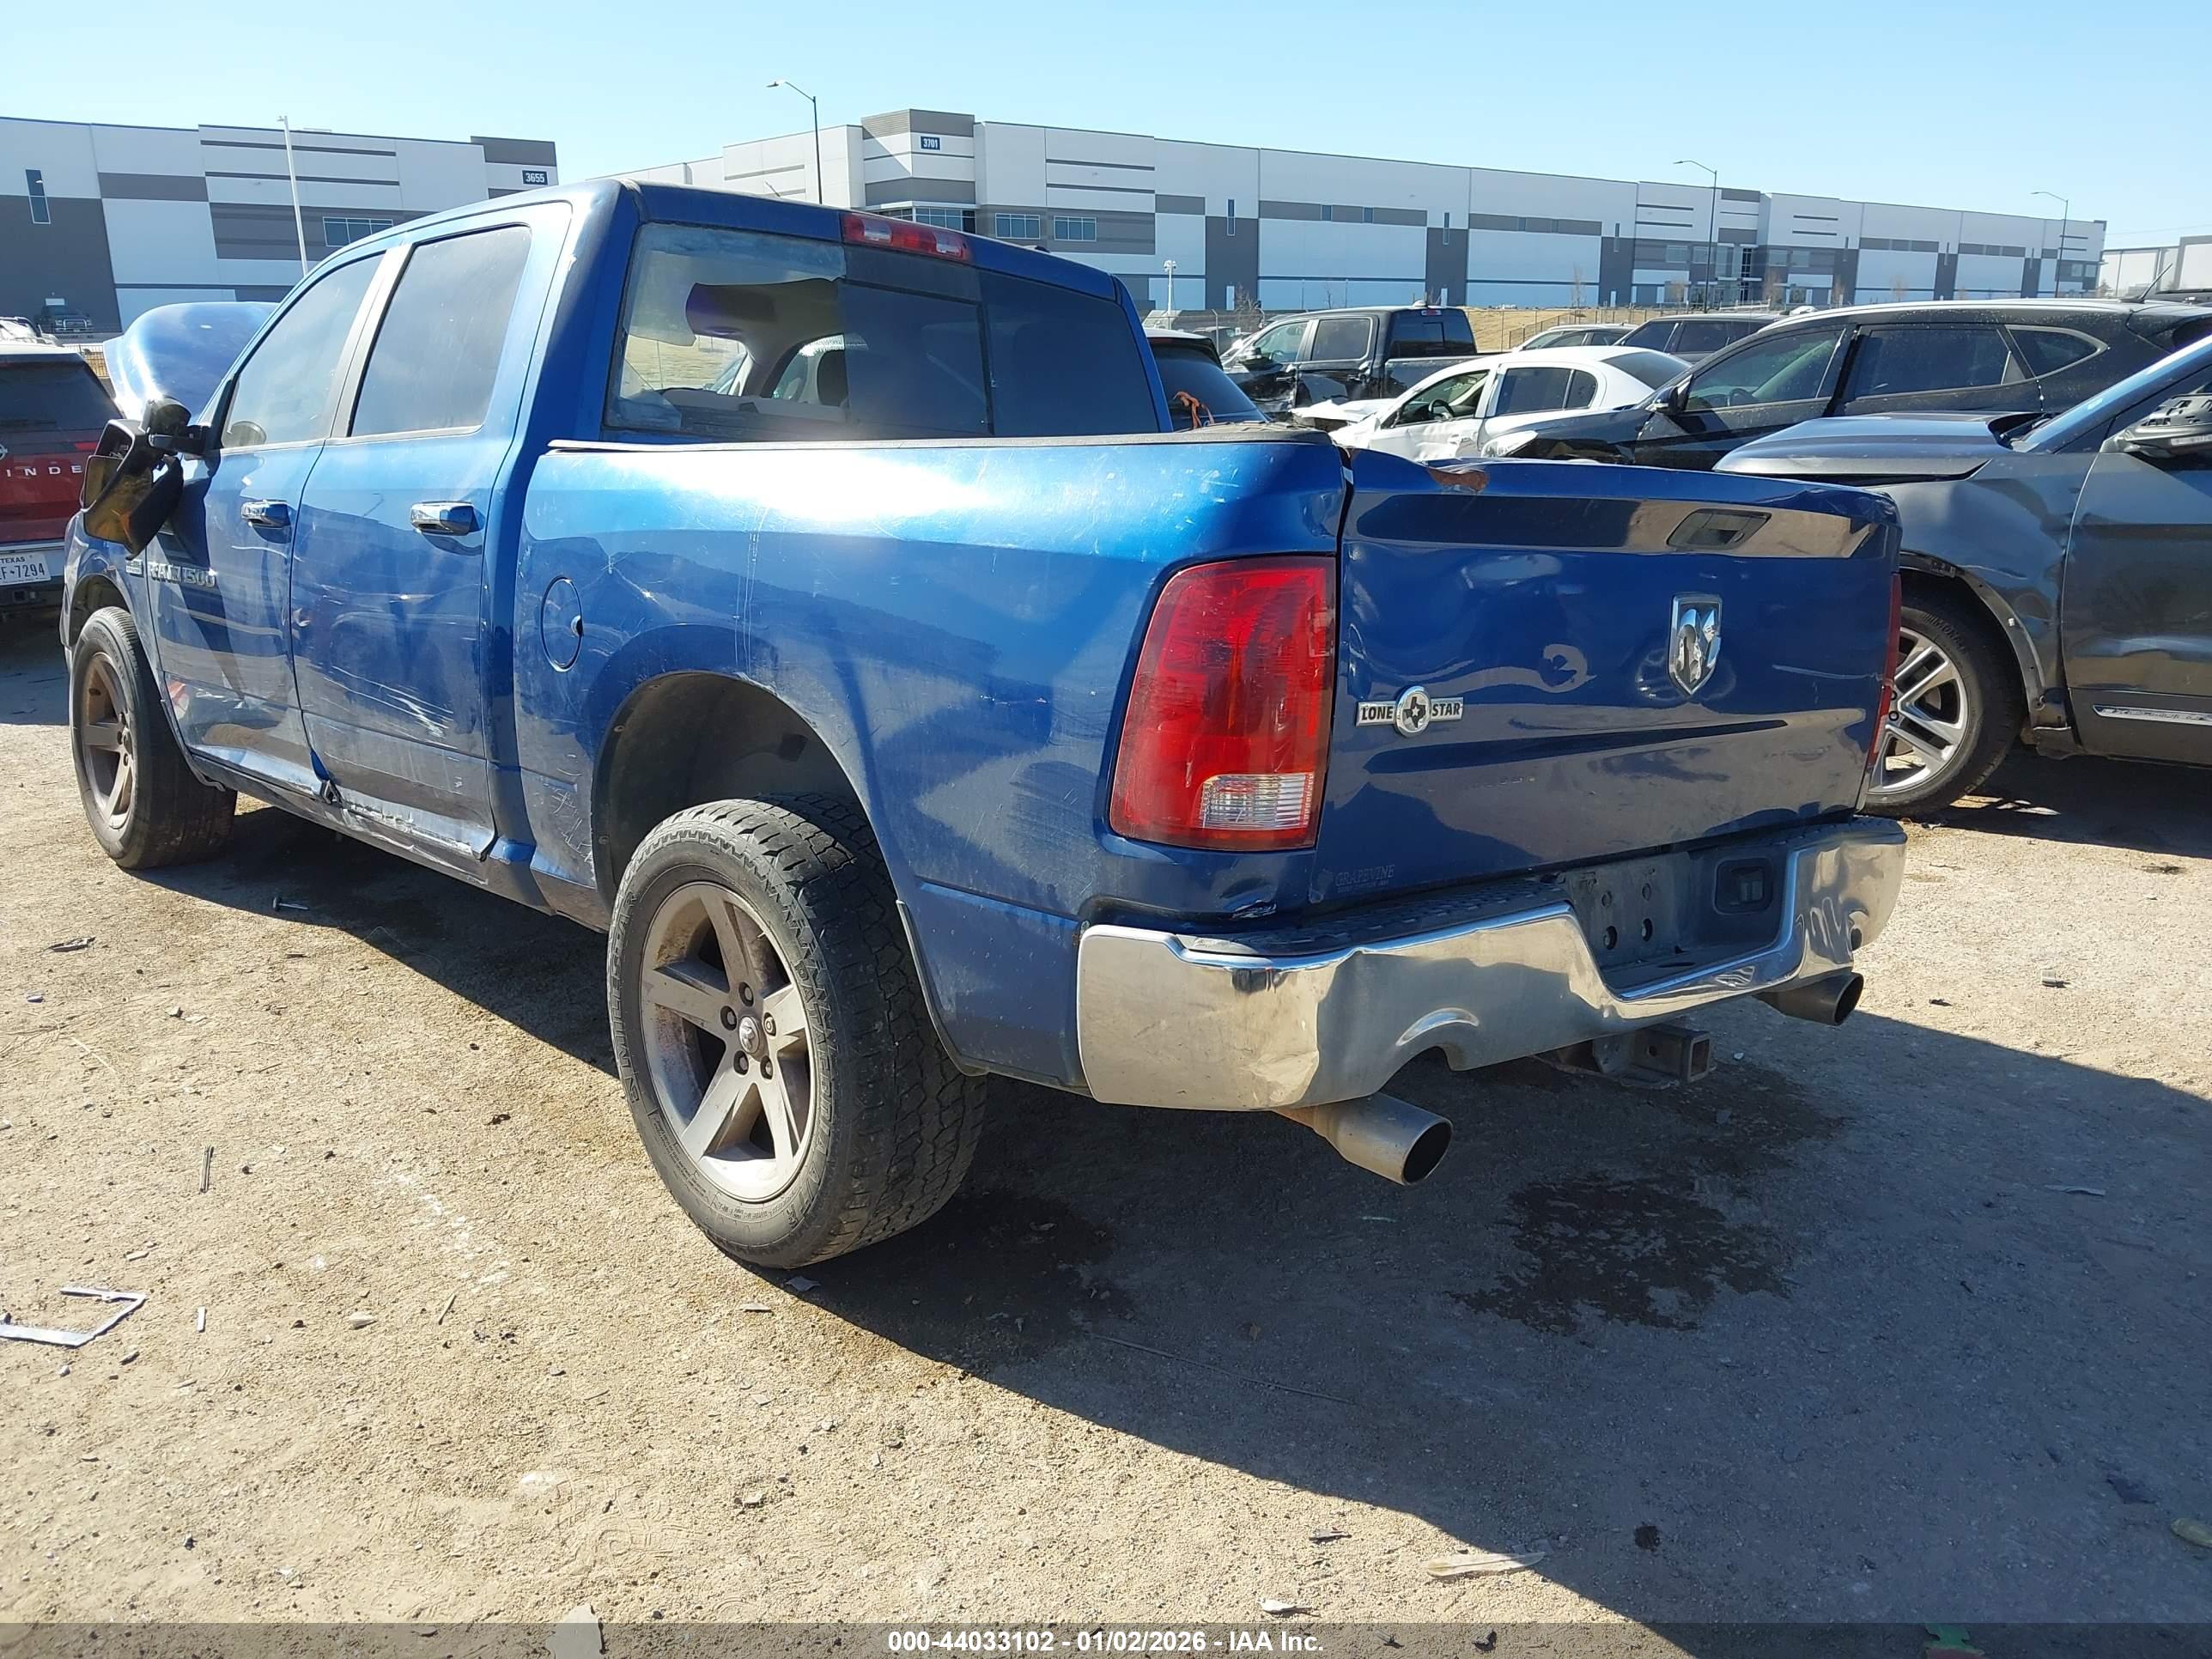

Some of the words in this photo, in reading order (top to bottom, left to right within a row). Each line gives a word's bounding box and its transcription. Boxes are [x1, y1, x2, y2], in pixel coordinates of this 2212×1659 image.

[923, 137, 938, 149] 3701
[526, 173, 544, 183] 3655
[0, 556, 25, 564] TEXAS
[14, 562, 45, 578] 7294
[1361, 706, 1393, 720] LONE
[1431, 702, 1460, 717] STAR
